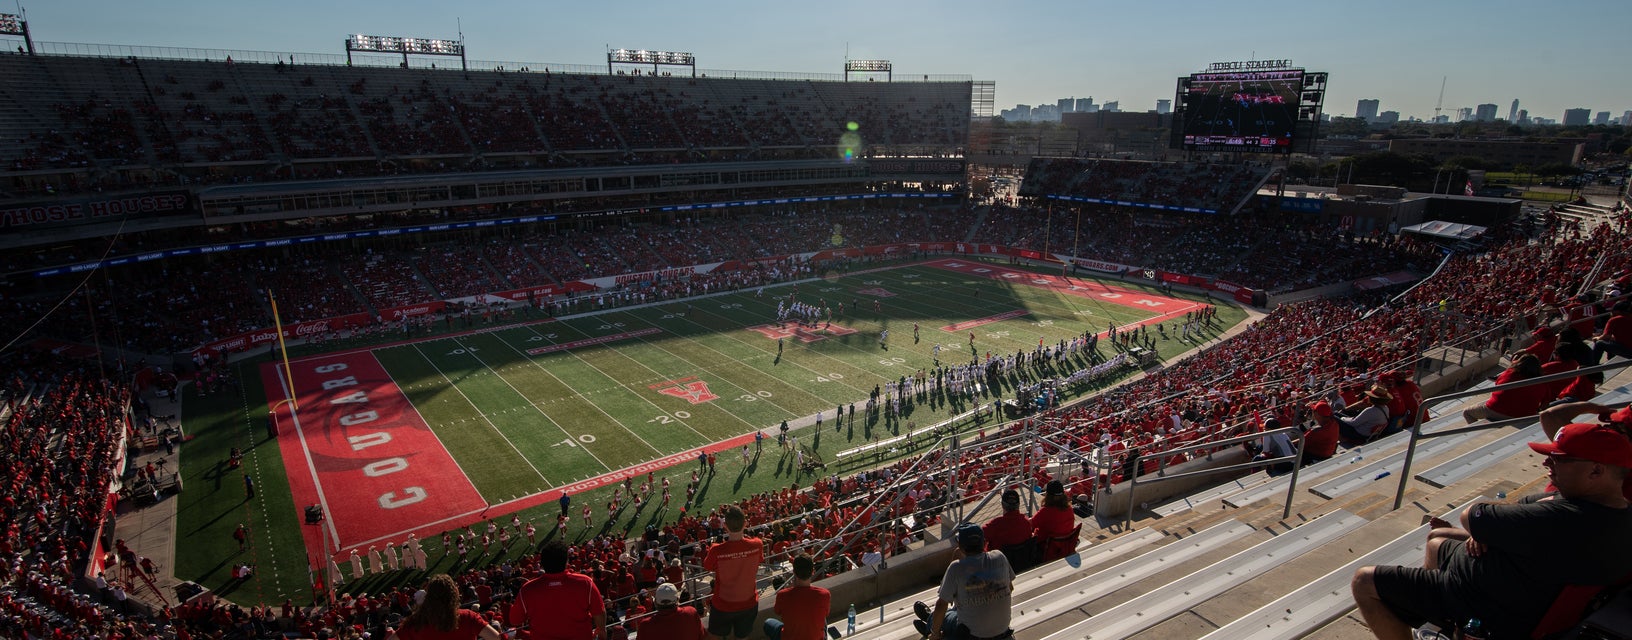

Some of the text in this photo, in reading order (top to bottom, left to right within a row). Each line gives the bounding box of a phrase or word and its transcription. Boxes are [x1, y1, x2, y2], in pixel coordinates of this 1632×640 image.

[1246, 60, 1288, 69] STADIUM
[0, 194, 188, 227] HOSE HOUSE?
[615, 266, 696, 285] HOUSTON COUGARS
[1582, 305, 1594, 317] 10
[250, 330, 289, 344] Lubys
[879, 357, 906, 367] 50
[817, 374, 844, 384] 40
[740, 390, 773, 402] 30
[654, 411, 691, 425] 20
[315, 363, 428, 509] COUGARS
[562, 434, 597, 449] 10
